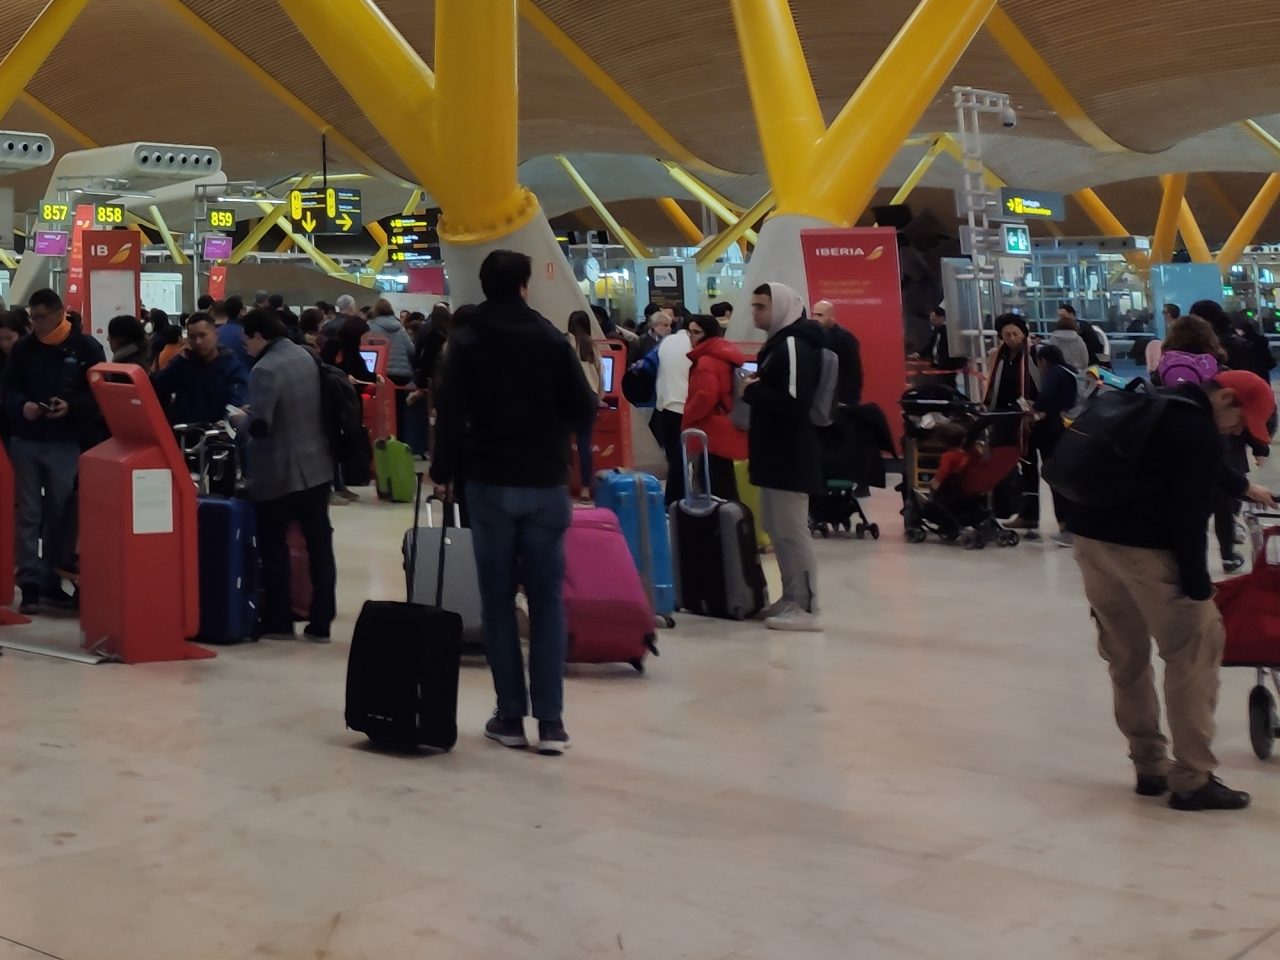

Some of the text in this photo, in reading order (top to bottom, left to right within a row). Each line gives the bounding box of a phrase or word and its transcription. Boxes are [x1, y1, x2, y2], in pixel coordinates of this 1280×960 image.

[43, 204, 68, 220] 857
[97, 206, 122, 223] 858
[211, 211, 233, 227] 859
[91, 244, 109, 256] IB
[816, 247, 865, 256] IBERIA
